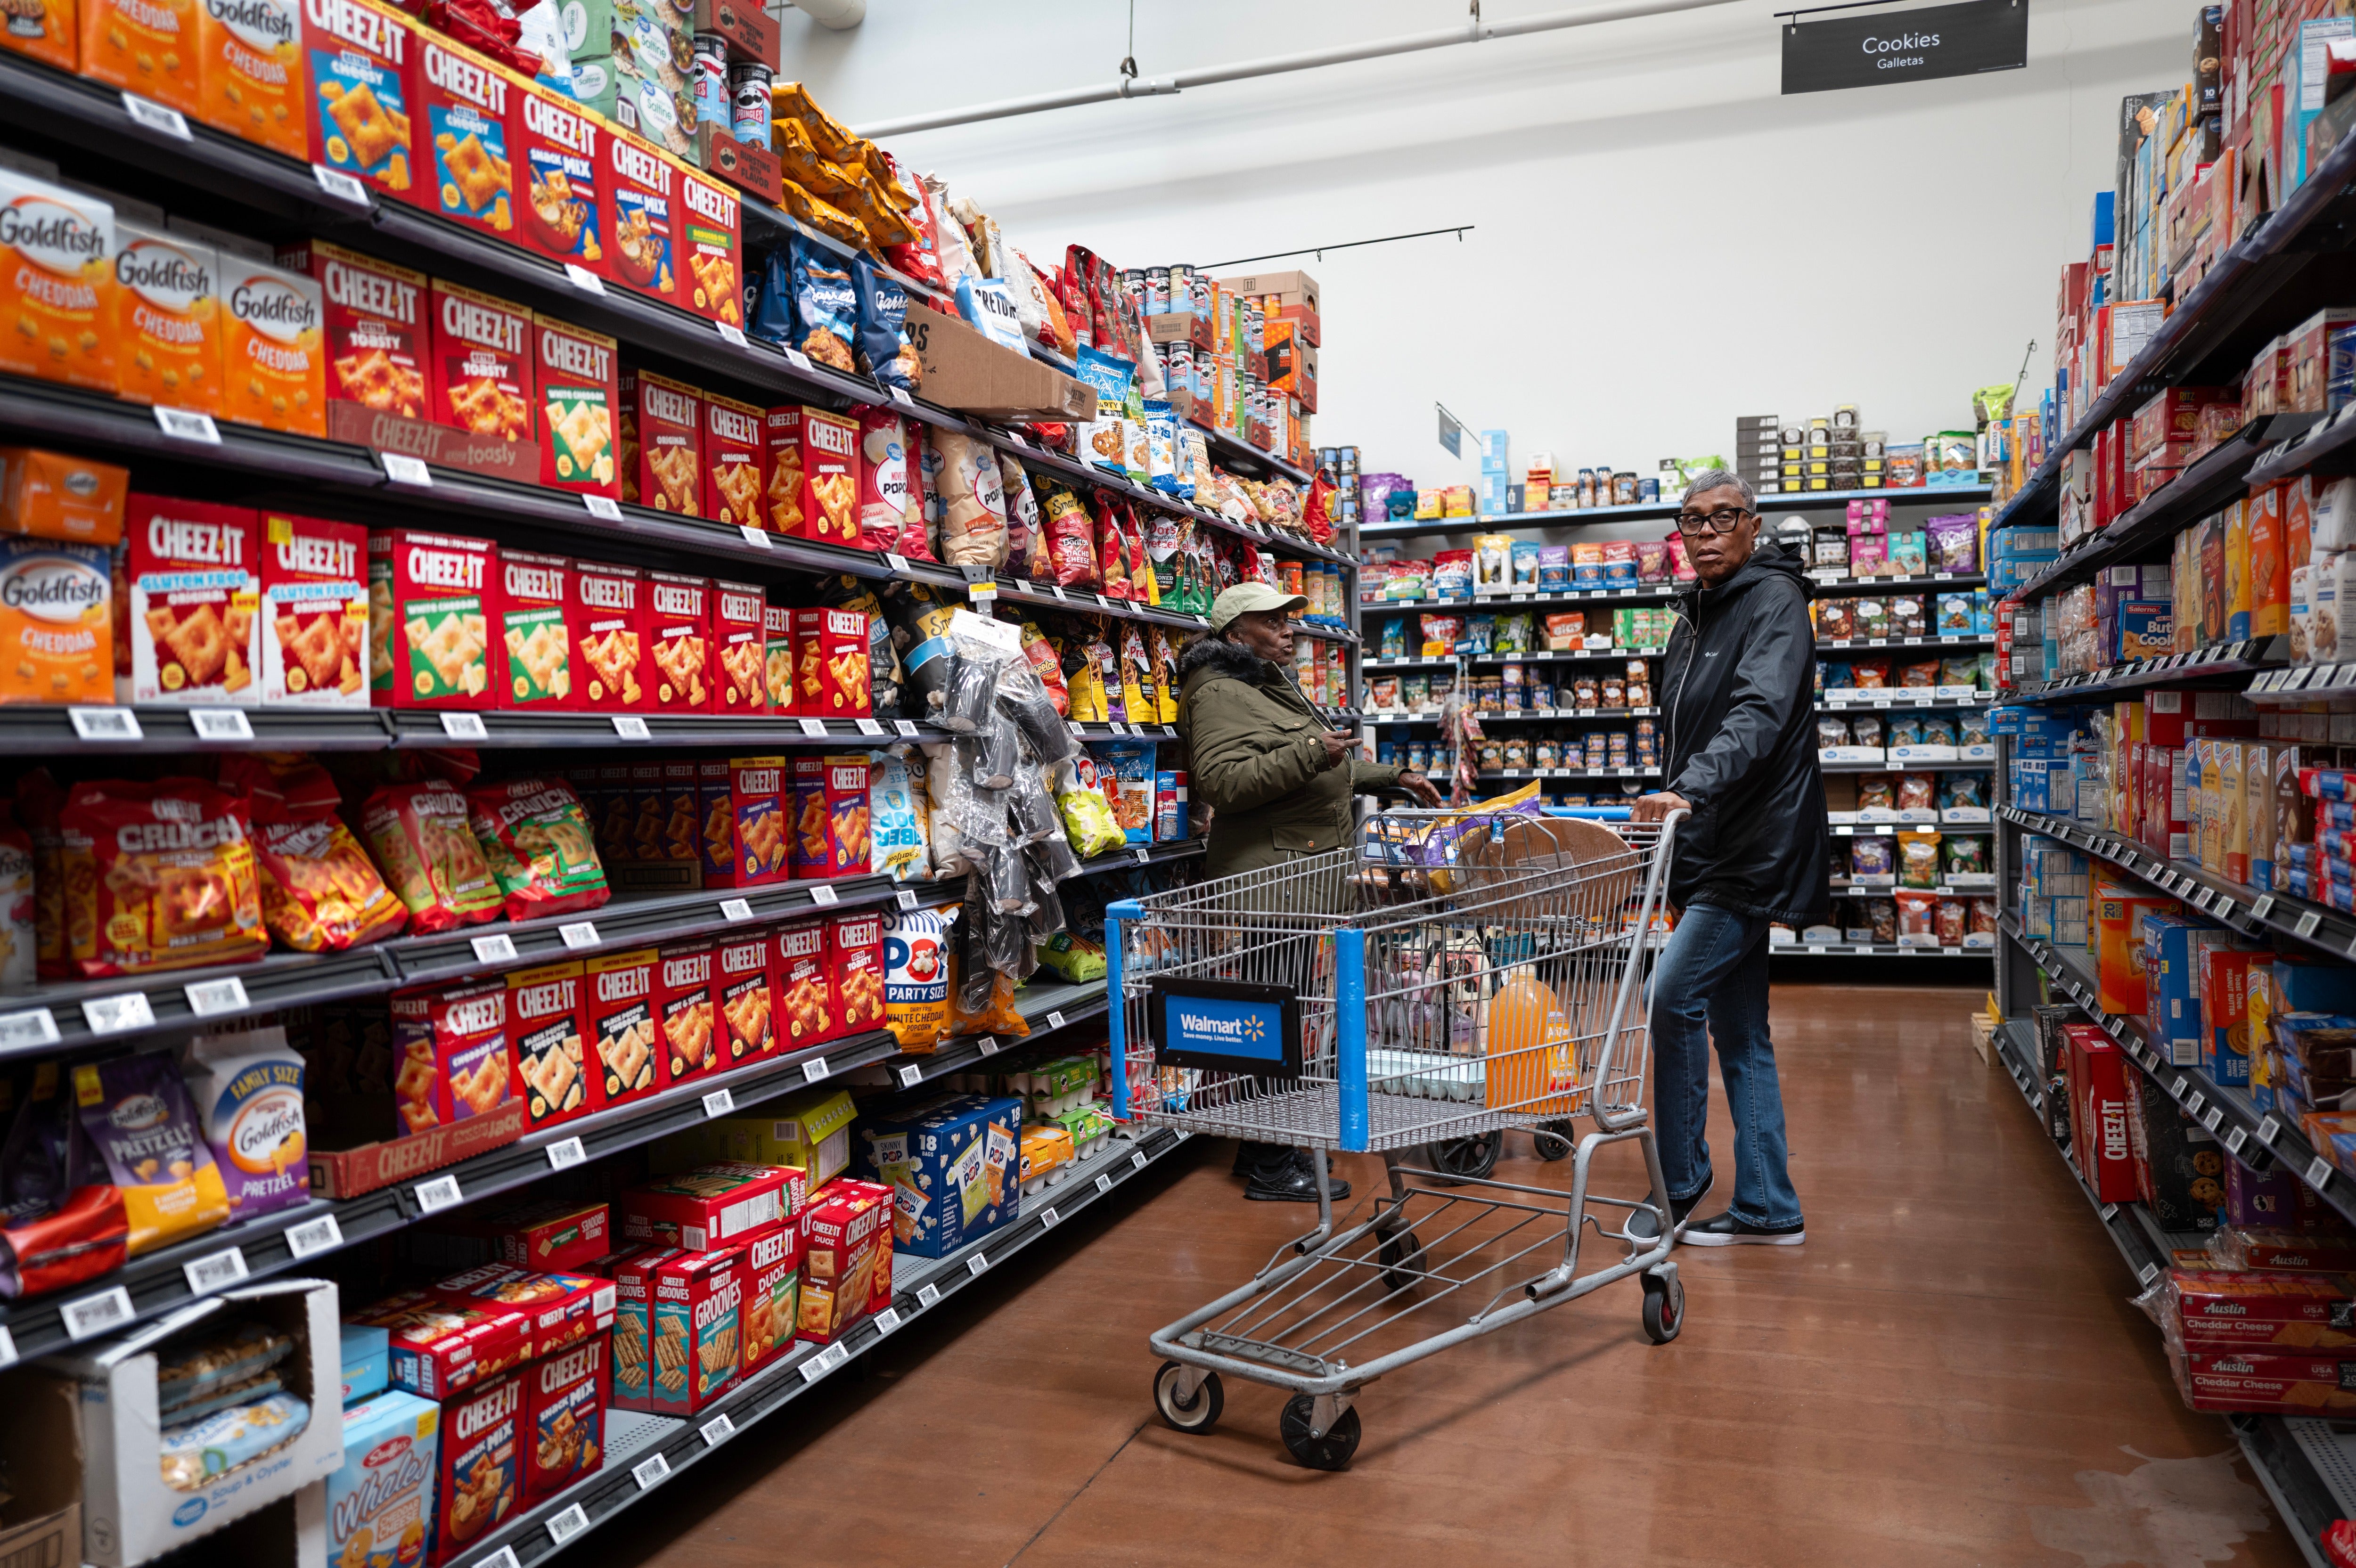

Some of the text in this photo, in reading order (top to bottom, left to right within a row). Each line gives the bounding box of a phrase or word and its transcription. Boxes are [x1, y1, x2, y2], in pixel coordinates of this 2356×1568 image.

[739, 16, 764, 40] BURSTING
[642, 35, 666, 58] Saltine
[740, 32, 763, 55] FLAVOR
[1863, 33, 1939, 54] Cookies
[223, 41, 287, 84] CHEDDAR
[1877, 56, 1923, 69] Galletas
[2204, 89, 2215, 97] 10
[647, 99, 672, 121] Saltine
[736, 108, 763, 122] PRINGLES
[740, 147, 770, 174] BURSTING
[741, 166, 769, 190] FLAVOR
[0, 207, 105, 255] Goldfish
[116, 250, 209, 295] Goldfish
[16, 269, 99, 309] CHEDDAR
[232, 286, 315, 327] Goldfish
[133, 306, 204, 343] CHEDDAR
[247, 337, 309, 371] CHEDDAR
[1106, 368, 1122, 376] FACTORY
[2179, 392, 2195, 401] RITZ
[888, 445, 901, 454] Great
[892, 472, 902, 481] MOVIE
[861, 508, 884, 518] Classic
[1149, 522, 1176, 535] Dot's
[1148, 534, 1176, 542] Homestyle
[4, 574, 103, 610] Goldfish
[873, 668, 890, 678] WHITE
[888, 849, 918, 865] Smartfood
[2104, 903, 2116, 918] 20
[1060, 937, 1071, 948] SALTY
[889, 986, 944, 1000] PARTY SIZE
[2226, 969, 2235, 1015] PEANUT BUTTER
[886, 1011, 944, 1023] WHITE CHEDDAR
[1181, 1014, 1242, 1035] Walmart
[907, 1024, 931, 1032] POPCORN
[1195, 1033, 1213, 1041] money.
[1225, 1036, 1243, 1044] better.
[2239, 1060, 2248, 1078] REAL
[230, 1066, 300, 1100] FAMILY SIZE
[1012, 1106, 1021, 1123] 18
[1085, 1117, 1095, 1125] SNACK
[241, 1111, 301, 1152] Goldfish
[109, 1123, 194, 1162] PRETZELS
[880, 1140, 900, 1151] SKINNY
[919, 1135, 937, 1151] 18
[991, 1134, 1007, 1147] SKINNY
[882, 1152, 902, 1163] POP
[989, 1146, 1004, 1165] POP
[1035, 1147, 1048, 1156] SNACK
[1038, 1154, 1048, 1162] CUPS
[962, 1148, 978, 1173] SKINNY
[964, 1161, 980, 1187] POP
[242, 1174, 295, 1198] PRETZEL
[790, 1177, 801, 1215] GROOVES
[900, 1187, 921, 1205] SKINNY
[895, 1196, 916, 1214] POP
[943, 1204, 957, 1212] deliciously
[943, 1210, 954, 1218] popped,
[943, 1215, 955, 1224] perfectly
[814, 1235, 835, 1246] DUOZ
[848, 1239, 869, 1268] DUOZ
[2269, 1254, 2309, 1266] Austin
[758, 1264, 785, 1293] DUOZ
[657, 1287, 689, 1300] GROOVES
[770, 1287, 776, 1297] &
[695, 1278, 741, 1330] GROOVES
[2204, 1303, 2247, 1315] Austin
[2187, 1320, 2274, 1331] Cheddar Cheese
[2211, 1360, 2254, 1372] Austin
[2195, 1377, 2282, 1389] Cheddar Cheese
[335, 1450, 433, 1543] Whales
[379, 1509, 421, 1544] CHEESE
